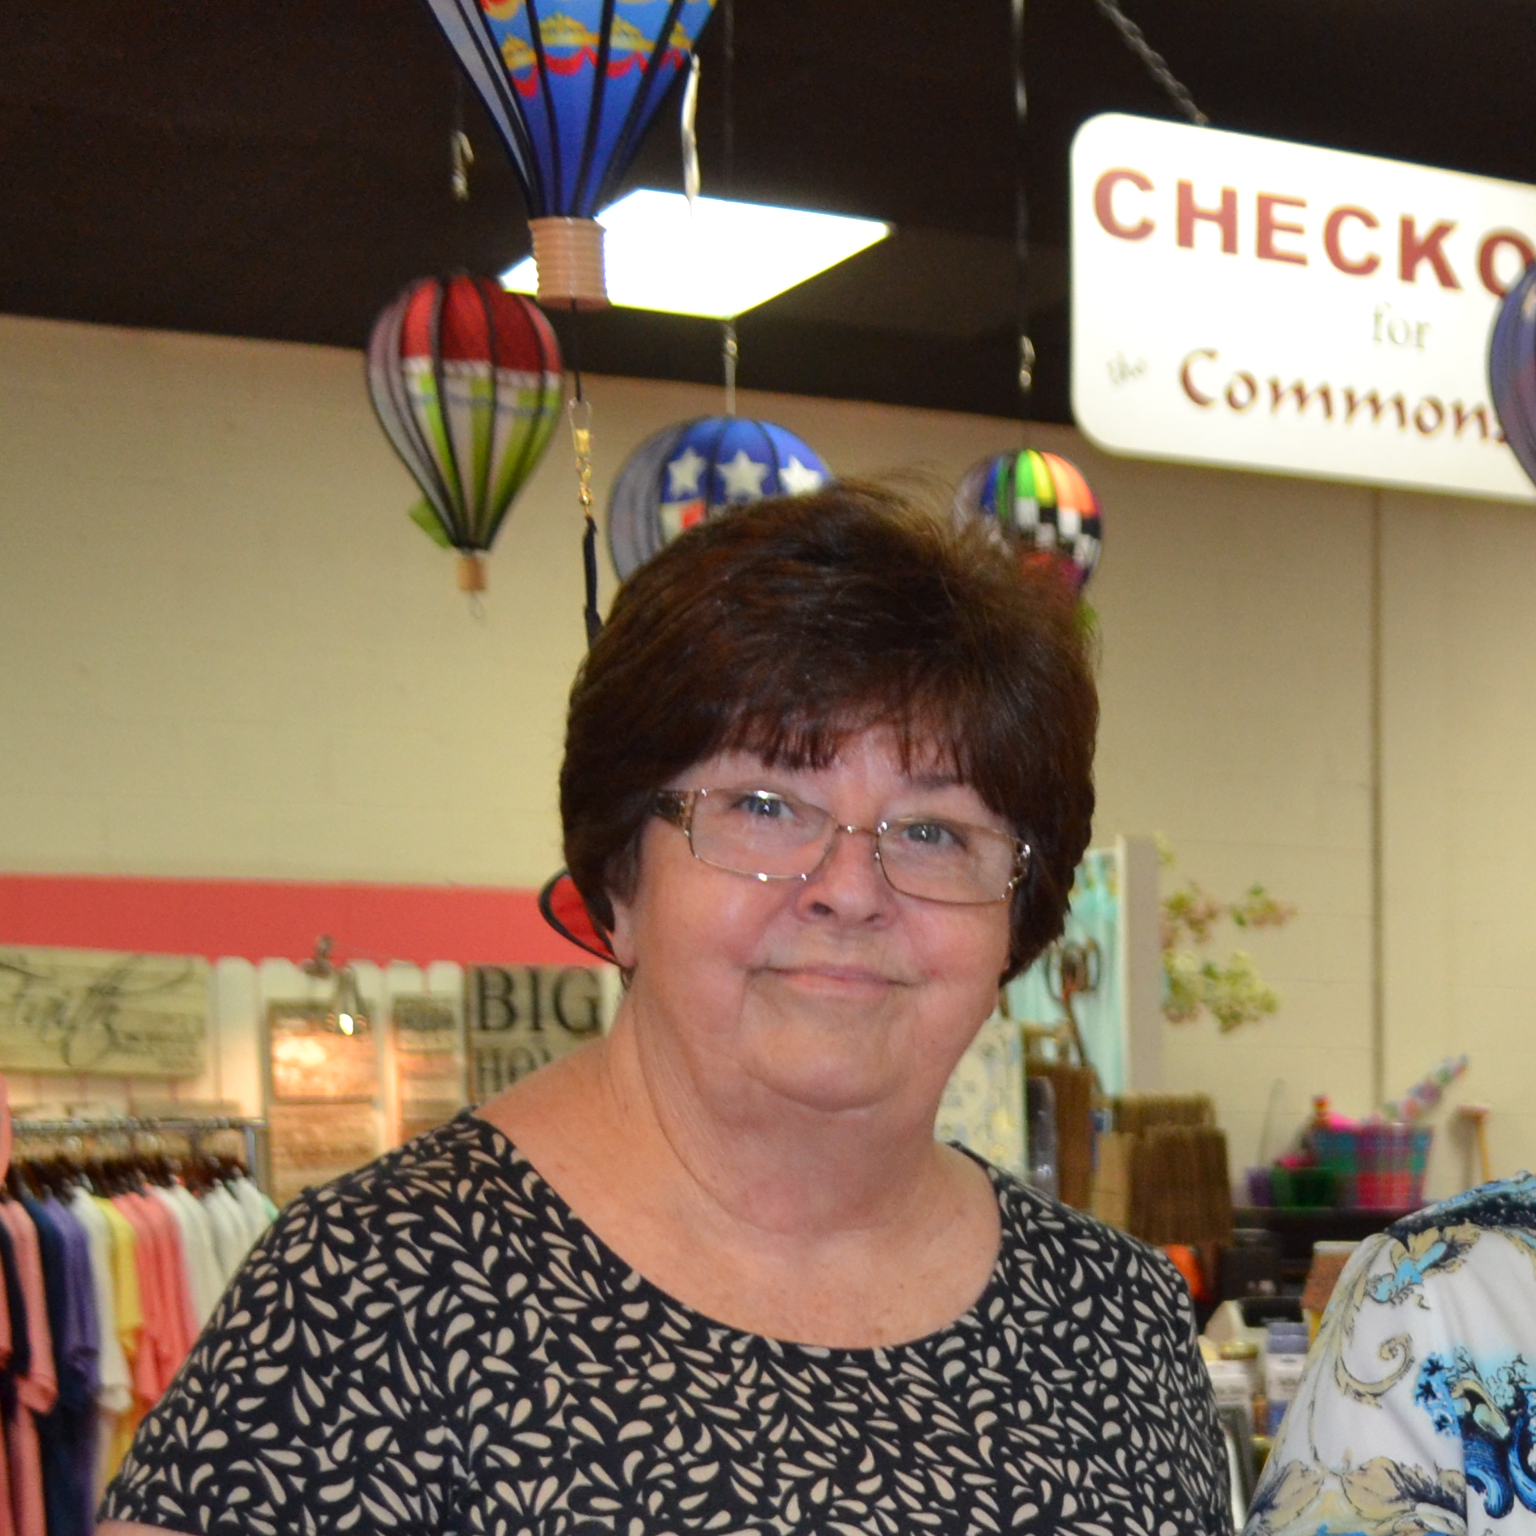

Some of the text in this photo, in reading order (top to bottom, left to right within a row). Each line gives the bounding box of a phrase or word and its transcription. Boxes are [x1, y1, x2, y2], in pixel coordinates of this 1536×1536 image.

[1370, 301, 1432, 350] for
[1105, 352, 1149, 387] the
[476, 966, 601, 1035] BIG
